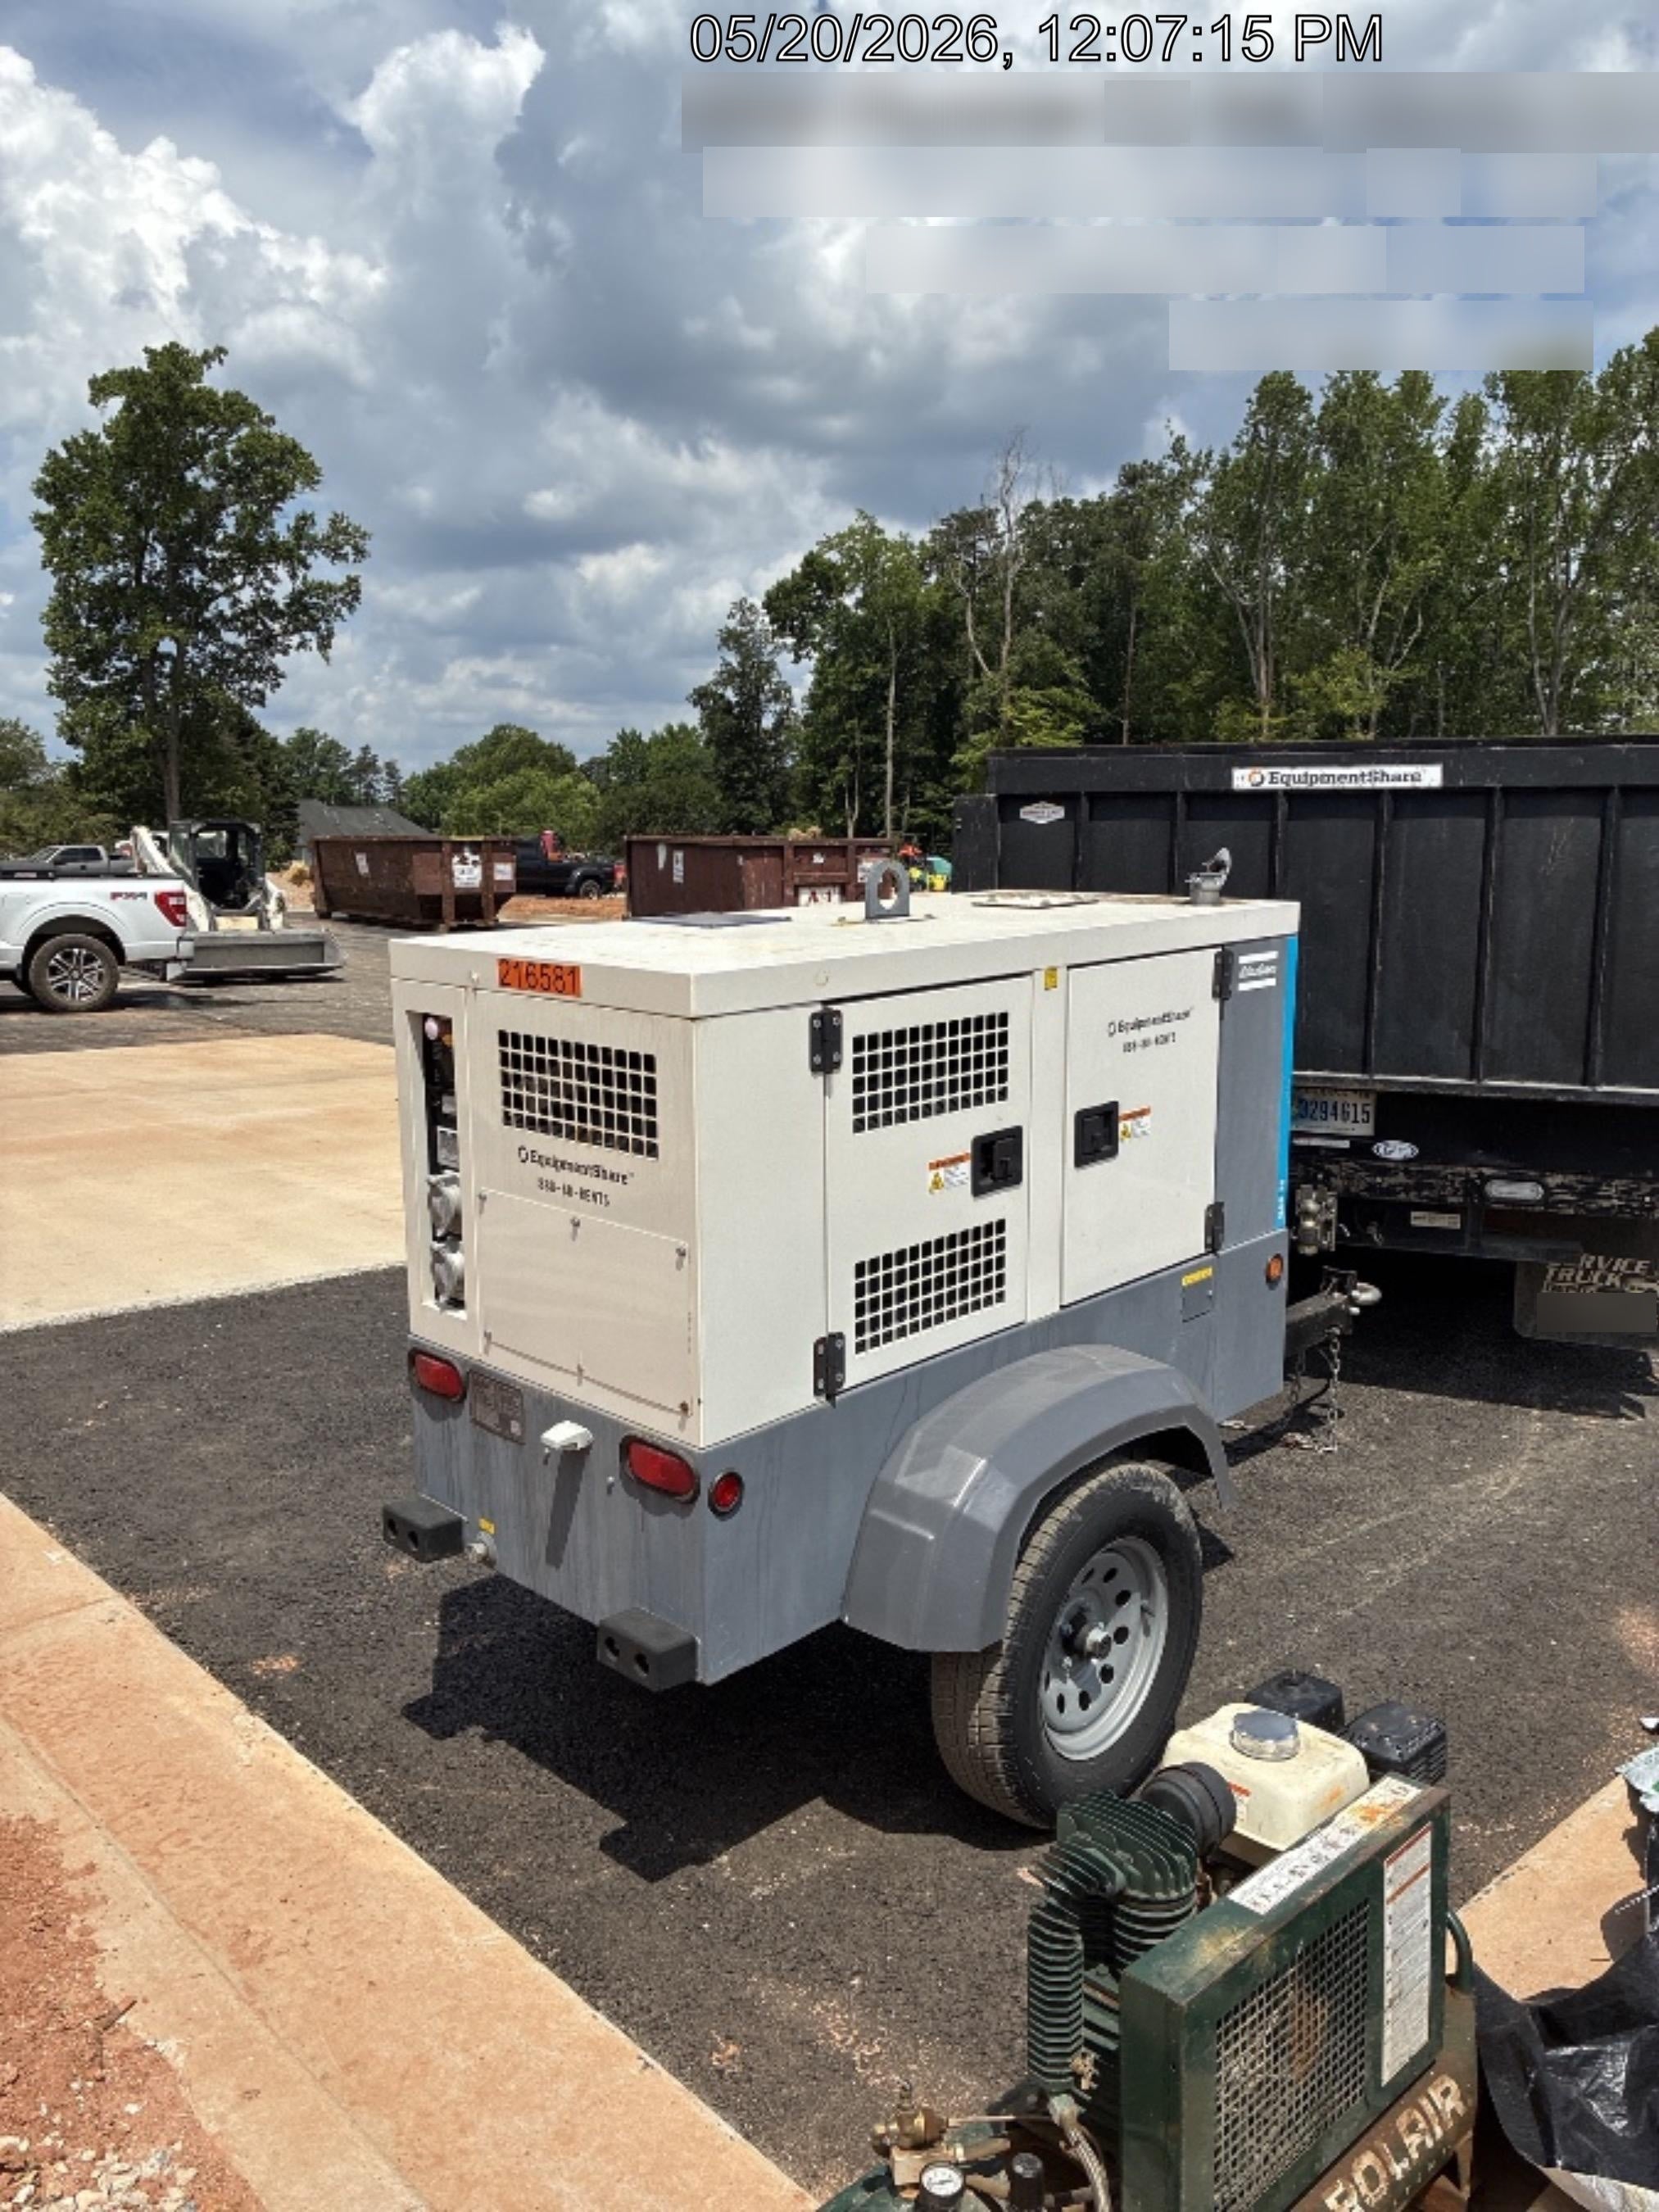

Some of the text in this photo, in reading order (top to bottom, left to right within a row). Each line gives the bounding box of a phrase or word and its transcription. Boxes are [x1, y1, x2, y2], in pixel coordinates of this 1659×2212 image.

[1268, 770, 1423, 787] EquipmentShare
[499, 959, 578, 995] 216581
[1545, 1262, 1624, 1288] TRUCK
